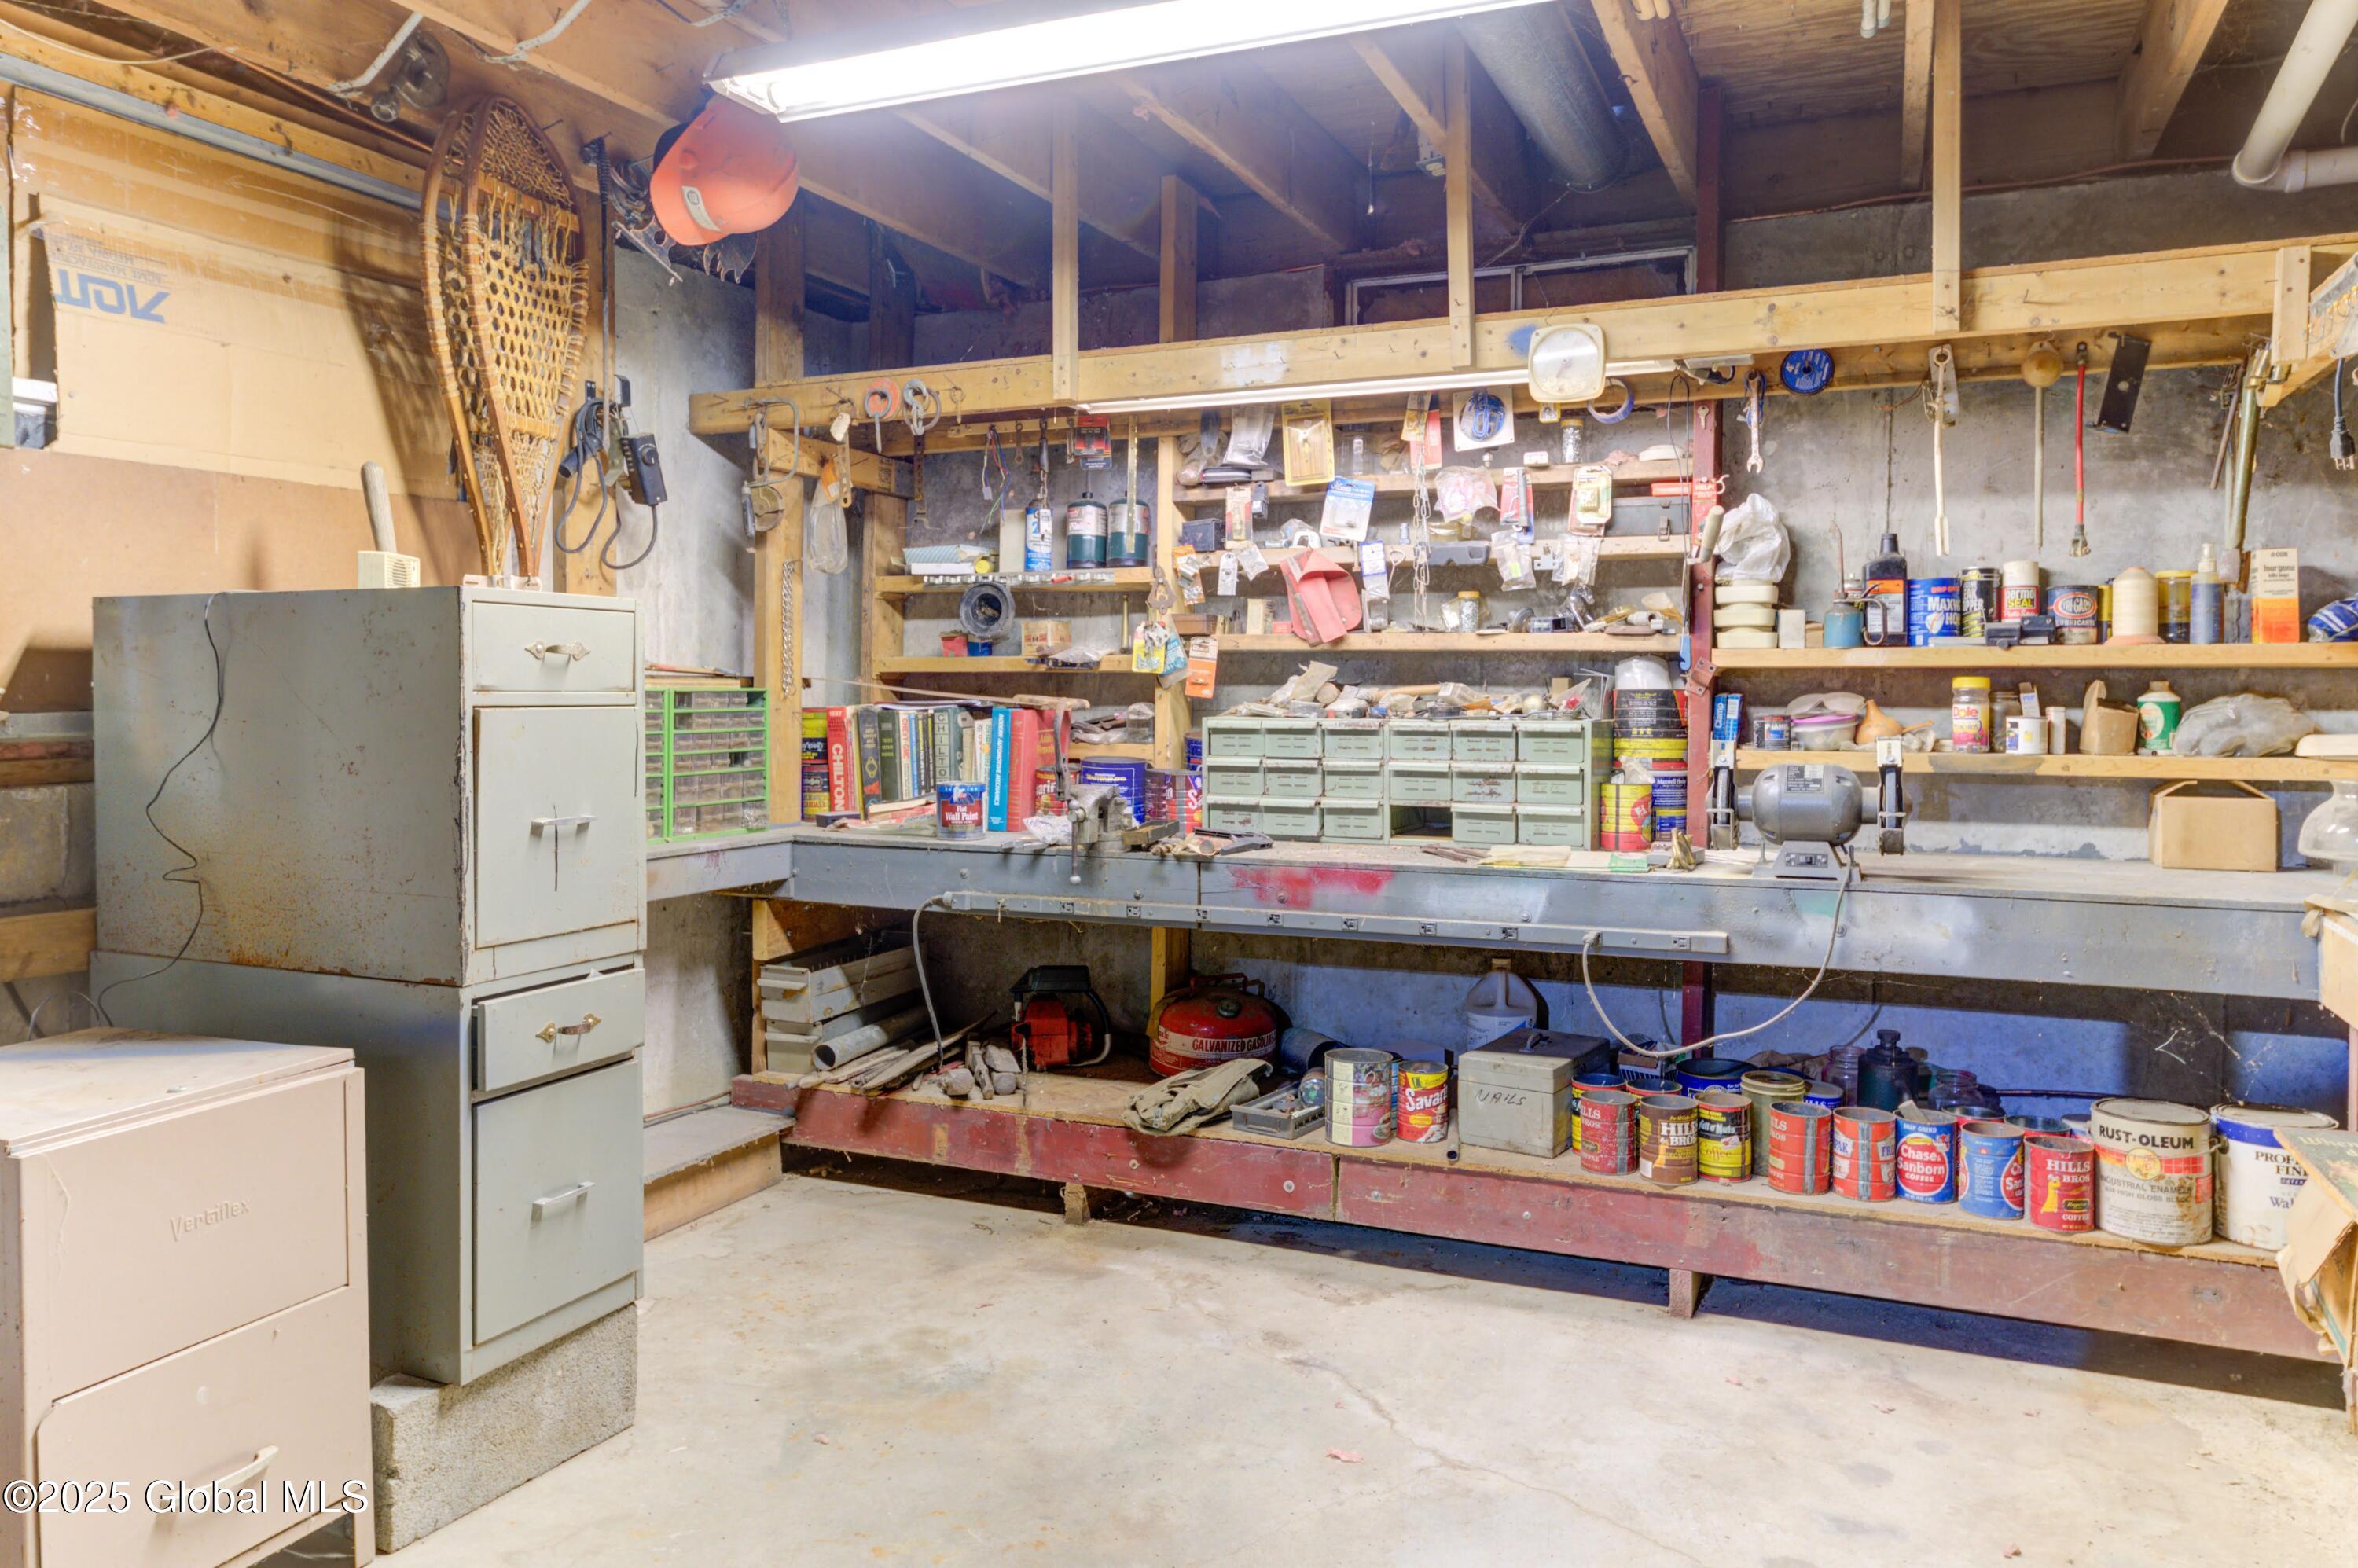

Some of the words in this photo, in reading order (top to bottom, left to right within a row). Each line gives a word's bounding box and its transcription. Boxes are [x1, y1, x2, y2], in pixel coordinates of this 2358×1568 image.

[2007, 598, 2033, 608] SEAL
[1714, 702, 1726, 729] Clamp
[1953, 706, 1978, 718] Dole
[832, 743, 846, 811] CHILTON
[945, 811, 960, 821] Wall
[961, 811, 979, 821] Paint
[1192, 1037, 1247, 1054] GALVANIZED
[1474, 1088, 1528, 1107] NAILS
[2099, 1124, 2195, 1150] RUST-OLEUM
[1900, 1144, 1937, 1162] Chase
[2254, 1151, 2297, 1165] PROF
[1897, 1157, 1945, 1177] Sanborn
[2045, 1159, 2091, 1173] HILLS
[1904, 1172, 1935, 1183] COFFEE
[2062, 1173, 2091, 1184] BROS
[2100, 1174, 2147, 1192] INDUSTRIAL
[169, 1197, 252, 1243] Vertiflex
